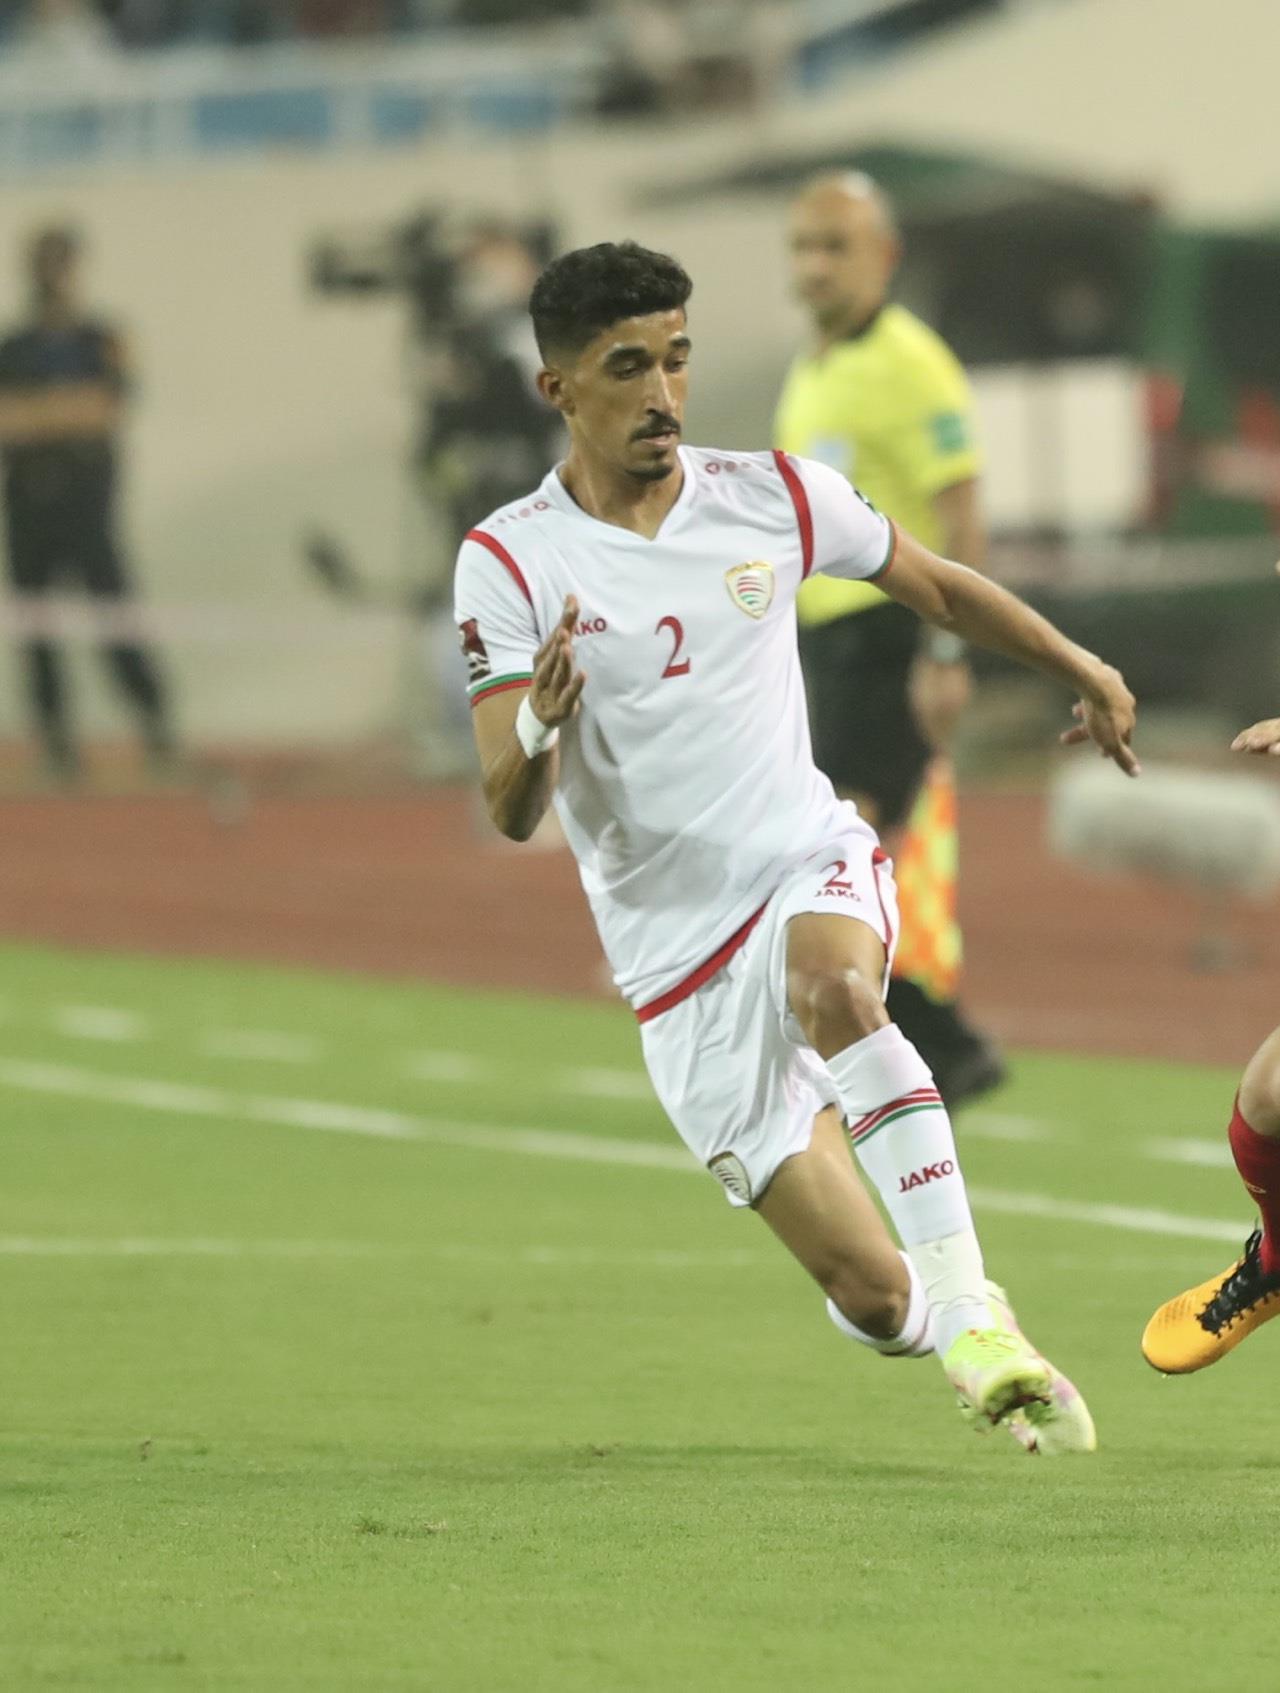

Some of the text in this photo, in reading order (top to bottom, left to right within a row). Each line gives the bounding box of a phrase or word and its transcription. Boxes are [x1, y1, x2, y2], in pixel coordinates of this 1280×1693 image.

[654, 616, 690, 679] 2
[820, 860, 852, 889] 2
[899, 1160, 954, 1193] JAKO
